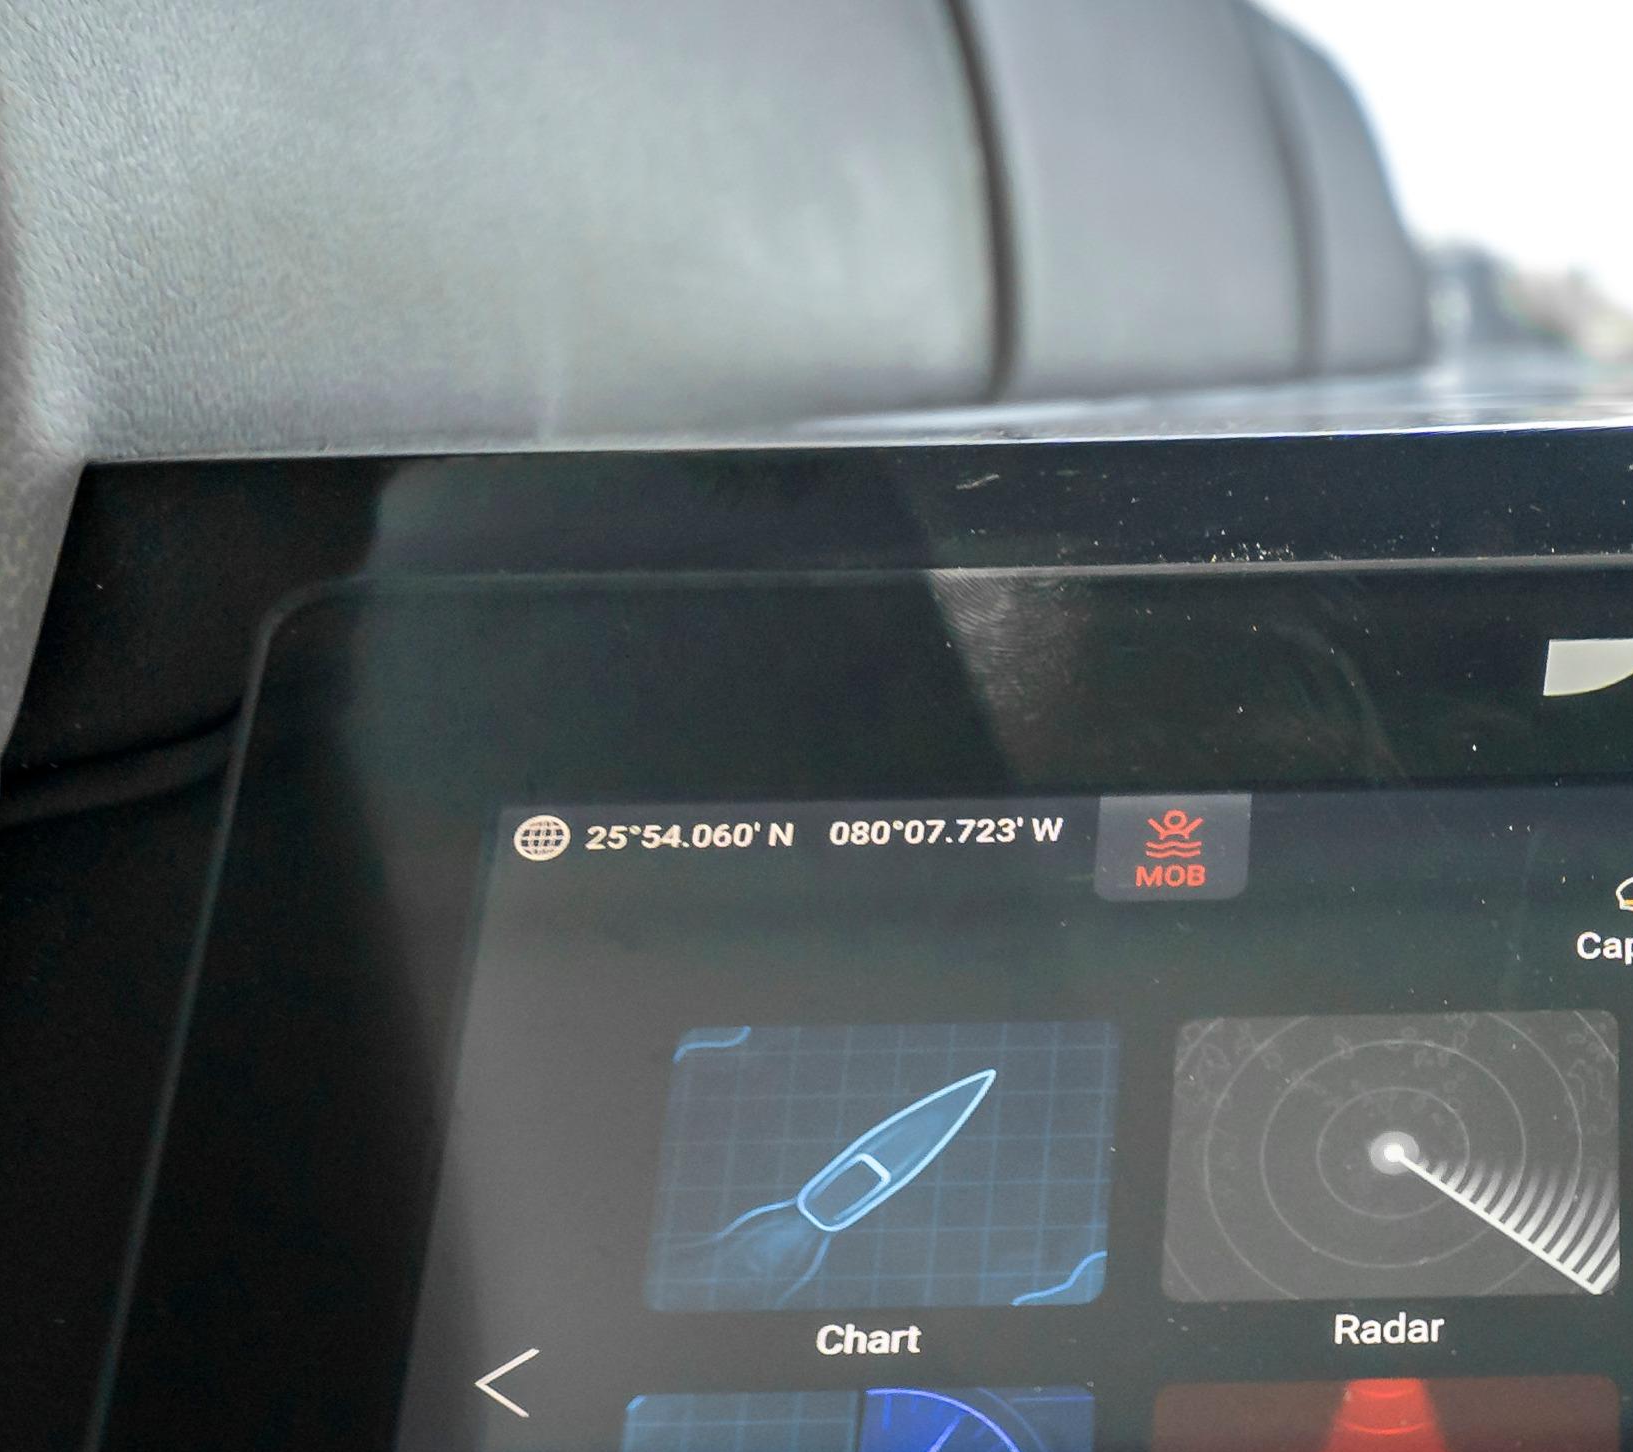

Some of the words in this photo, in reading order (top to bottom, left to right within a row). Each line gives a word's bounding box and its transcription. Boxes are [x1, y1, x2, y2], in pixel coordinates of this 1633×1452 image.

[768, 822, 795, 847] N
[1032, 817, 1064, 842] W
[1135, 863, 1206, 888] MOB
[815, 1323, 922, 1356] Chart
[1334, 1311, 1445, 1345] Radar
